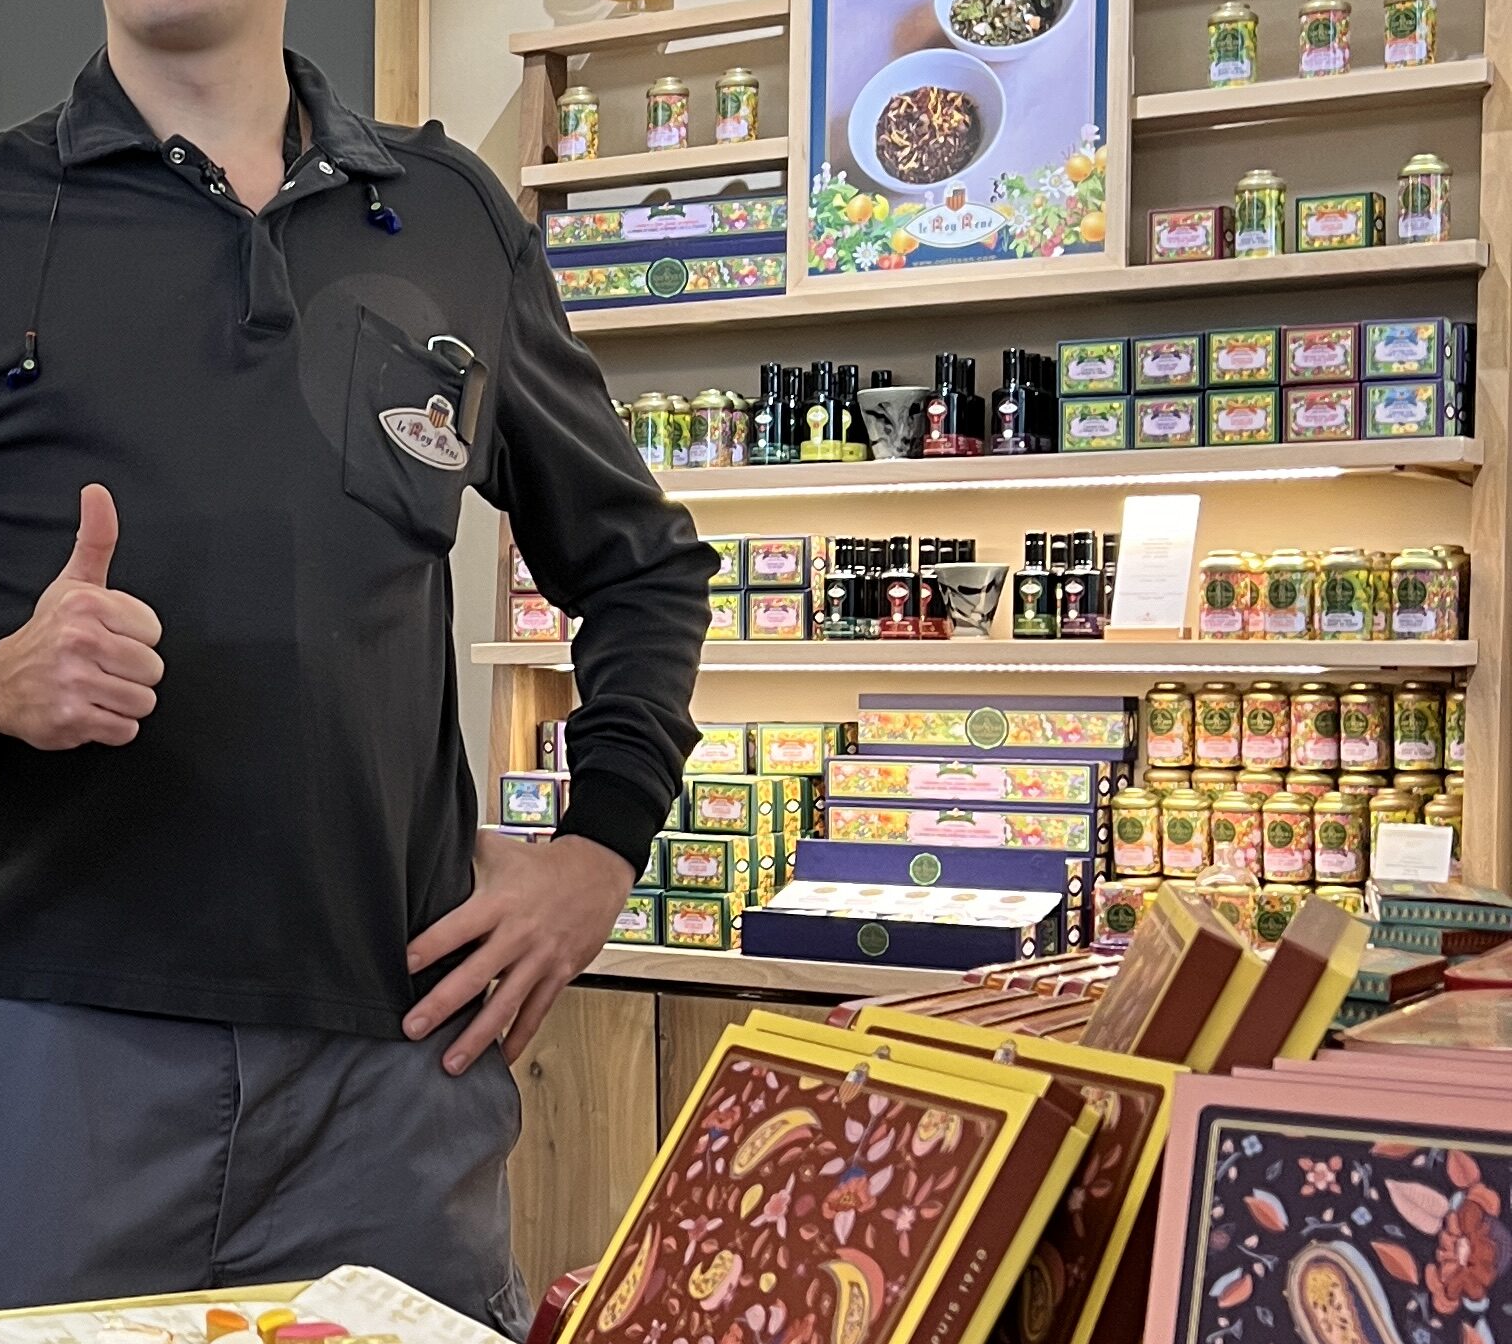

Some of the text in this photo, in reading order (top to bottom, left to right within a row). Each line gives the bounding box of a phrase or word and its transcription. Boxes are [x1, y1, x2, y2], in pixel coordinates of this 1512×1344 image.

[919, 212, 993, 236] le Roy René
[409, 421, 433, 447] Roy
[959, 1249, 988, 1293] 1920
